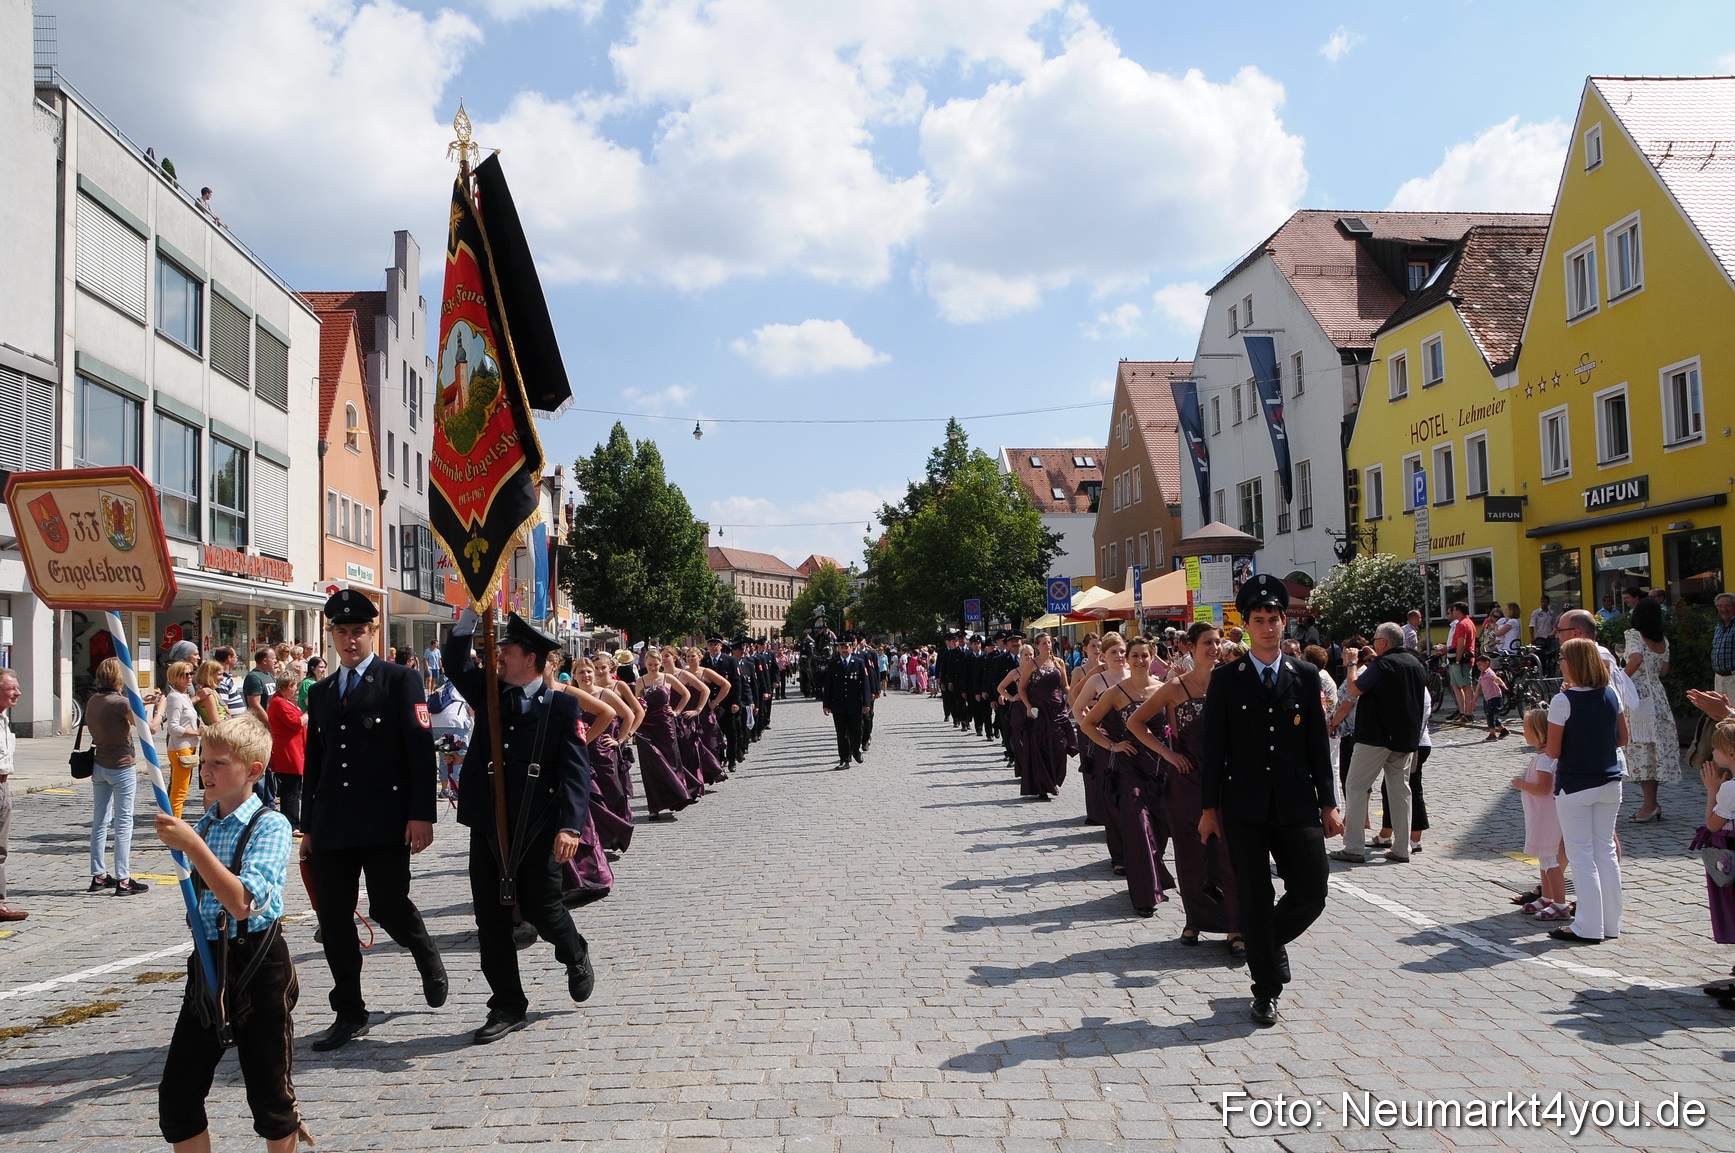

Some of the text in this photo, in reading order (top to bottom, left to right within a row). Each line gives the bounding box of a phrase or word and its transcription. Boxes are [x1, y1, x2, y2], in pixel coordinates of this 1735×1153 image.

[1410, 397, 1506, 445] HOTEL Lehmeier
[431, 449, 464, 482] emeinde
[1416, 476, 1424, 503] P
[1581, 480, 1639, 508] TAIFUN
[1487, 511, 1520, 519] TAIFUN
[47, 557, 146, 592] Engelsberg
[204, 544, 294, 582] MARIEN-APOTHEKE
[1134, 569, 1140, 590] P
[1050, 603, 1069, 611] TAXI
